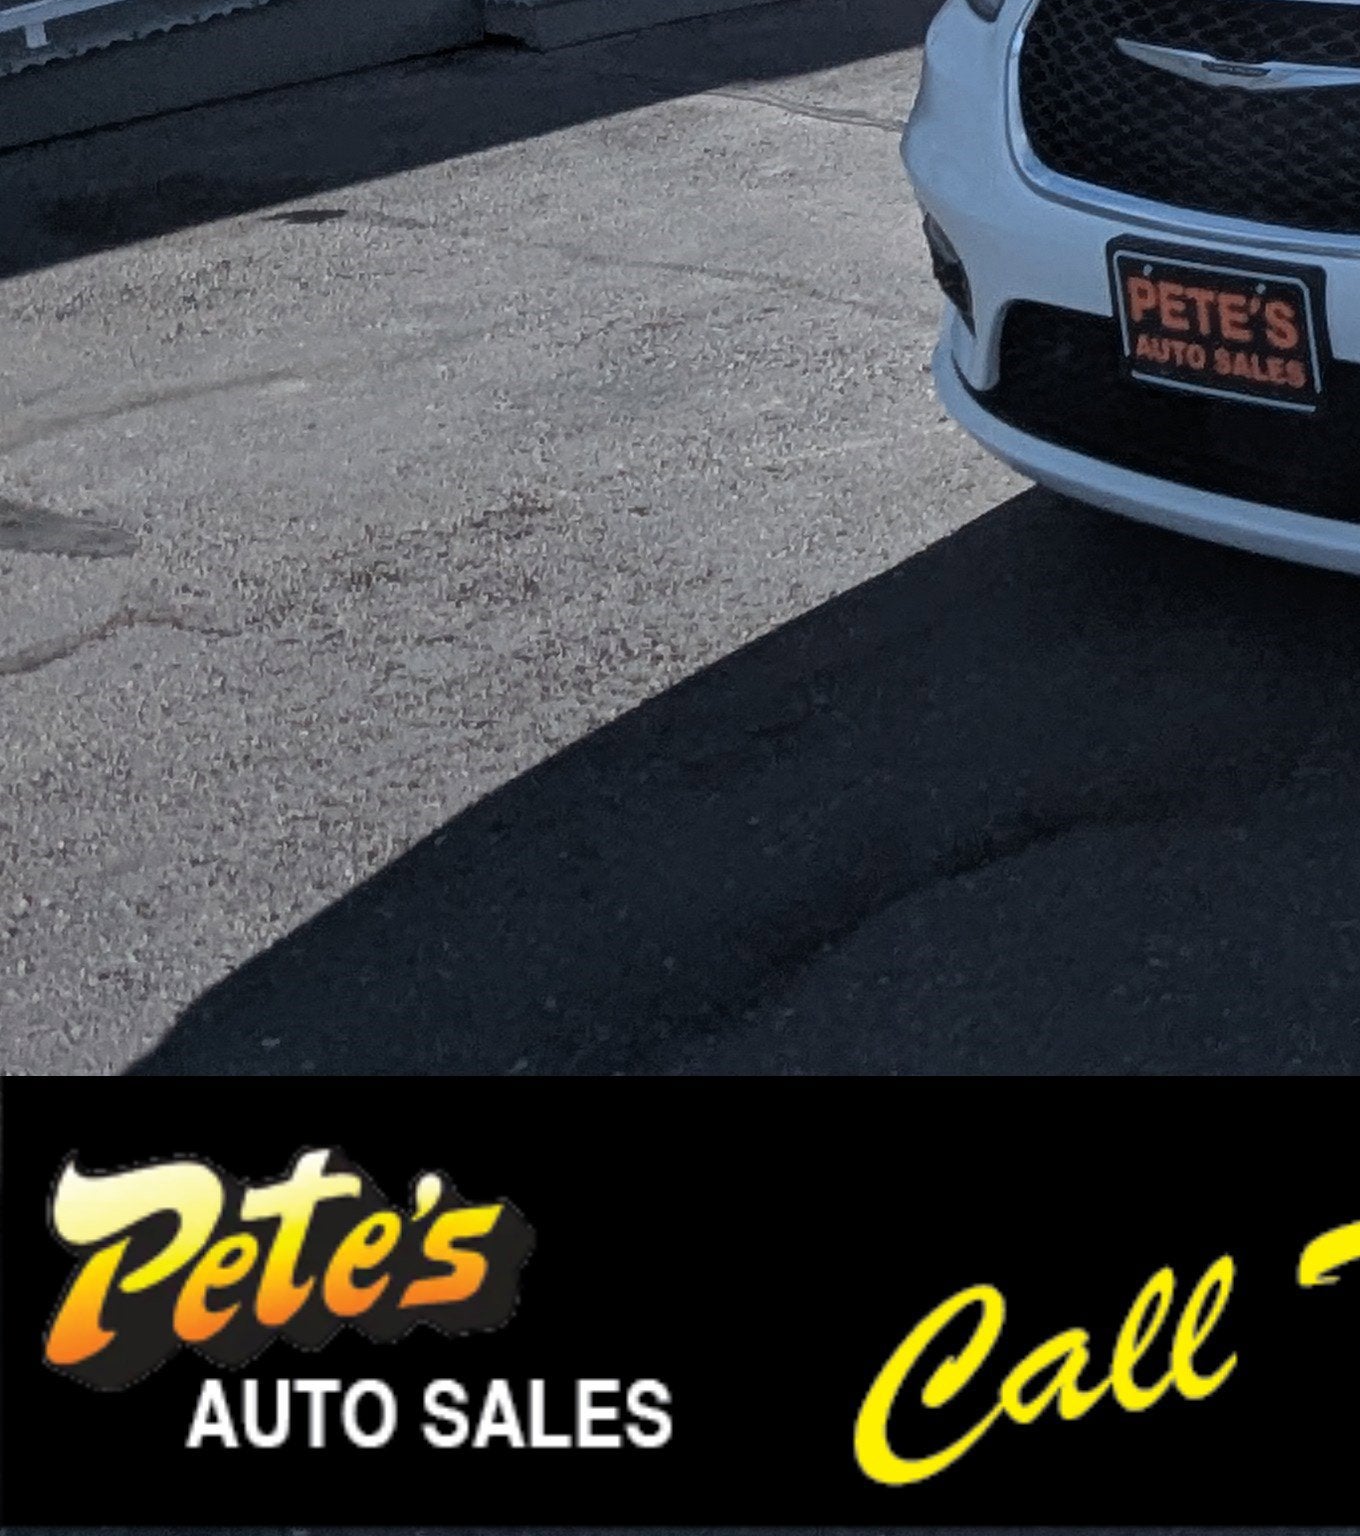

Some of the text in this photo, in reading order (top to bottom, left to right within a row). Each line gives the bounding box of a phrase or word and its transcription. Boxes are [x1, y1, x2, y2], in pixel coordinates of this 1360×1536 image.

[1127, 276, 1298, 349] PETE'S
[1136, 333, 1306, 388] AUTO SALES
